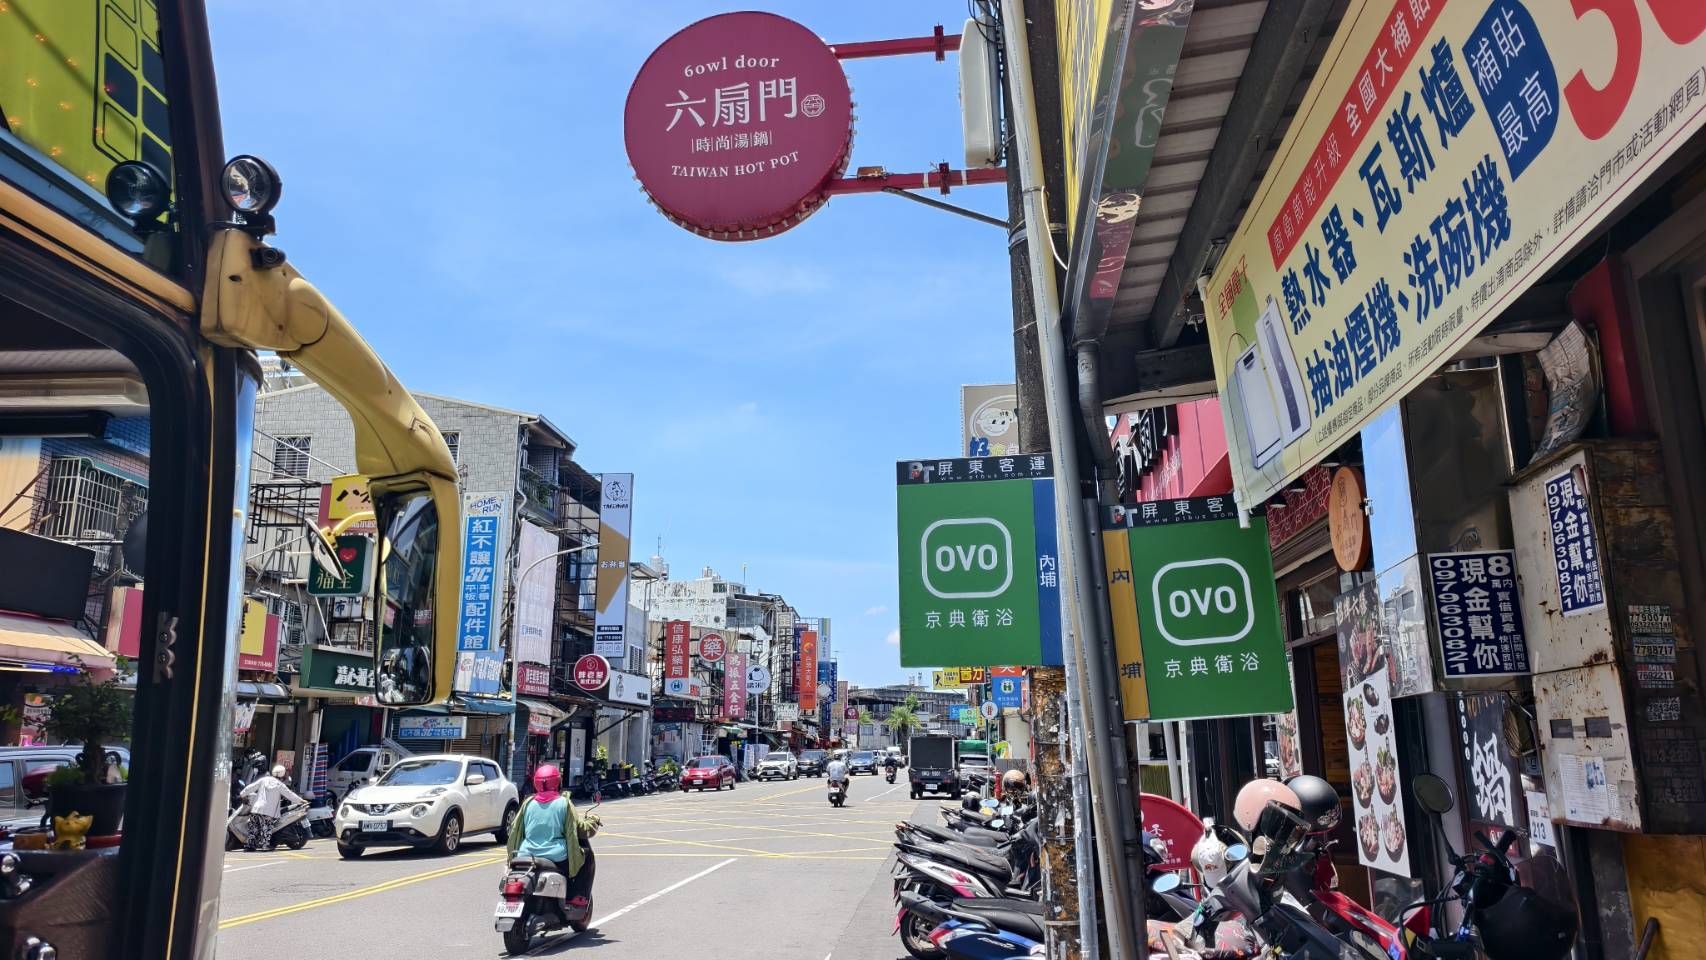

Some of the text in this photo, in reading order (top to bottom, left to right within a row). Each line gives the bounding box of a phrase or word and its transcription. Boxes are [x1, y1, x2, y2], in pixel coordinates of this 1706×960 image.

[1470, 6, 1526, 96] 補貼
[684, 54, 780, 77] 6owl door
[665, 77, 797, 131] 六扇門
[1497, 71, 1553, 158] 最高
[695, 131, 769, 153] 時尚湯鍋
[671, 151, 799, 177] TAIWAN HOT POT
[938, 456, 1046, 476] 屏東客運
[470, 496, 497, 510] HOME
[482, 502, 502, 514] RUN
[1548, 478, 1589, 609] 現金幫你 0979630821
[934, 543, 998, 573] OVO
[1039, 555, 1057, 588] 內埔
[1169, 586, 1237, 619] OVO
[1433, 558, 1501, 673] 現金幫你 0979630821
[924, 608, 1014, 629] 京典衛浴
[1164, 652, 1260, 679] 京典衛浴
[1532, 821, 1546, 840] 213
